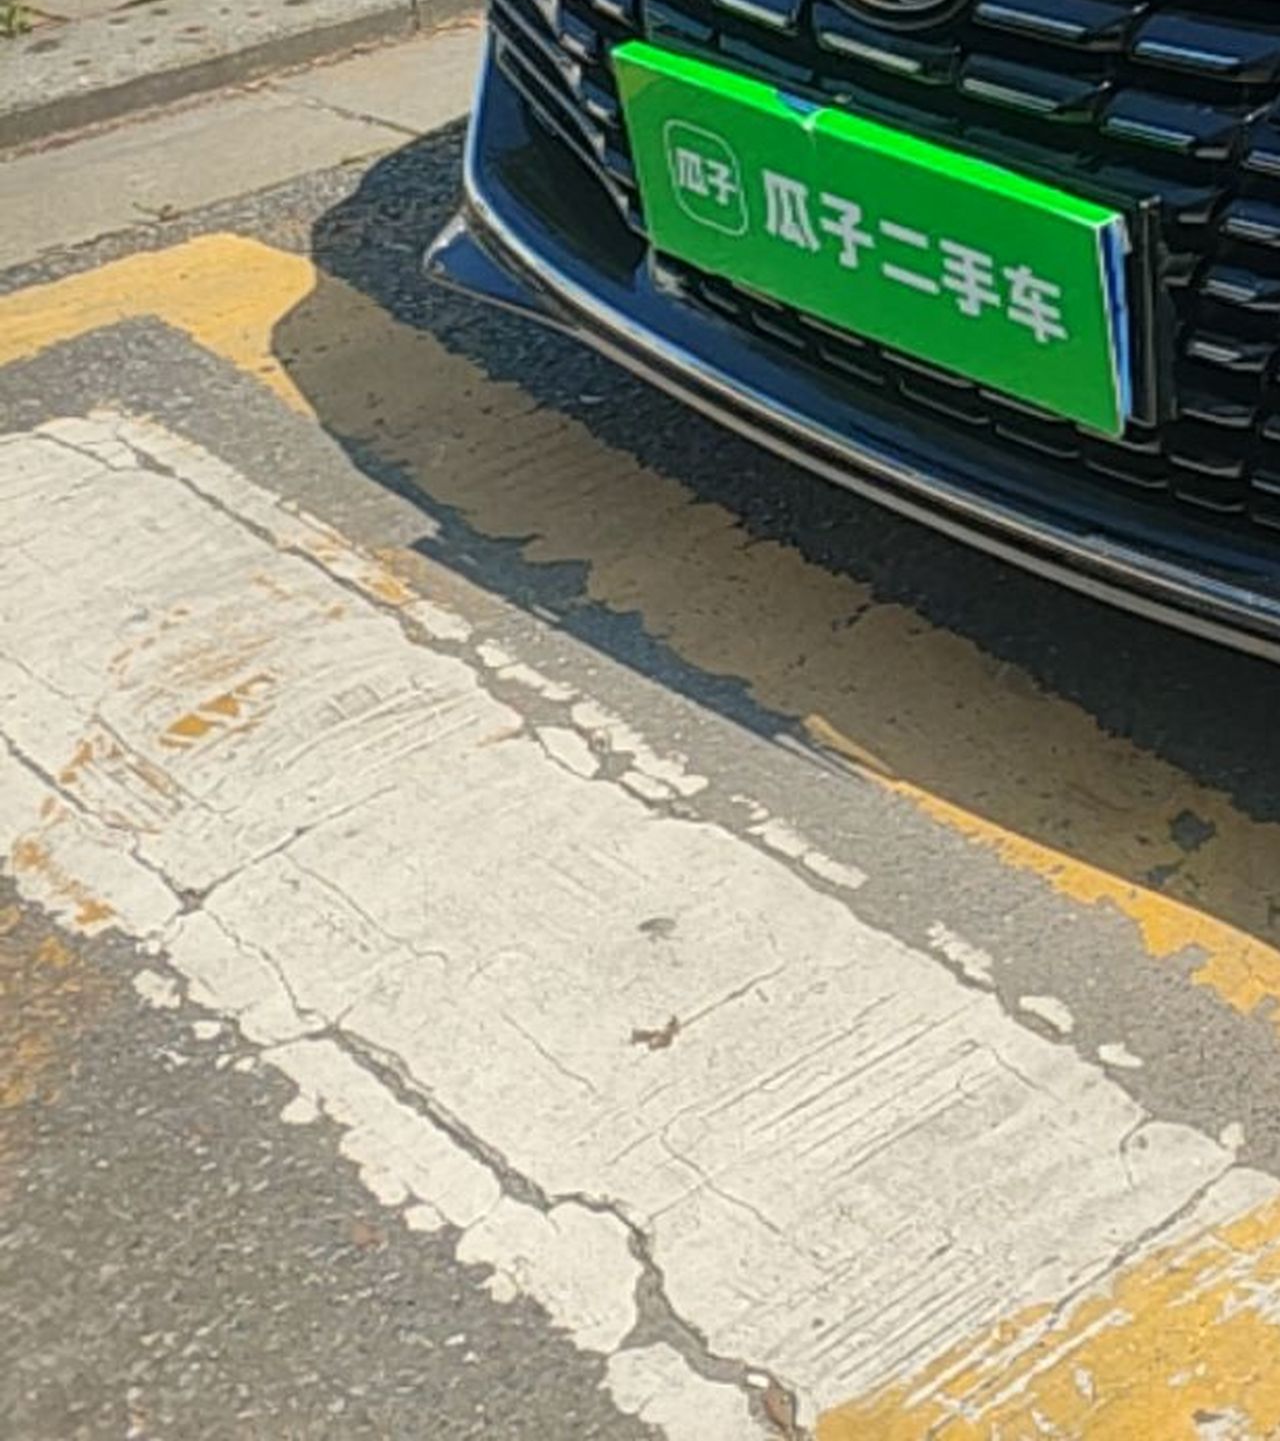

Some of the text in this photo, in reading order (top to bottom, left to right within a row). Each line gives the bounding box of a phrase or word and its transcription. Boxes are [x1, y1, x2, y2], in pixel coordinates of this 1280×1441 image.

[675, 146, 740, 206] 瓜子
[761, 168, 1068, 343] 瓜子二手车
